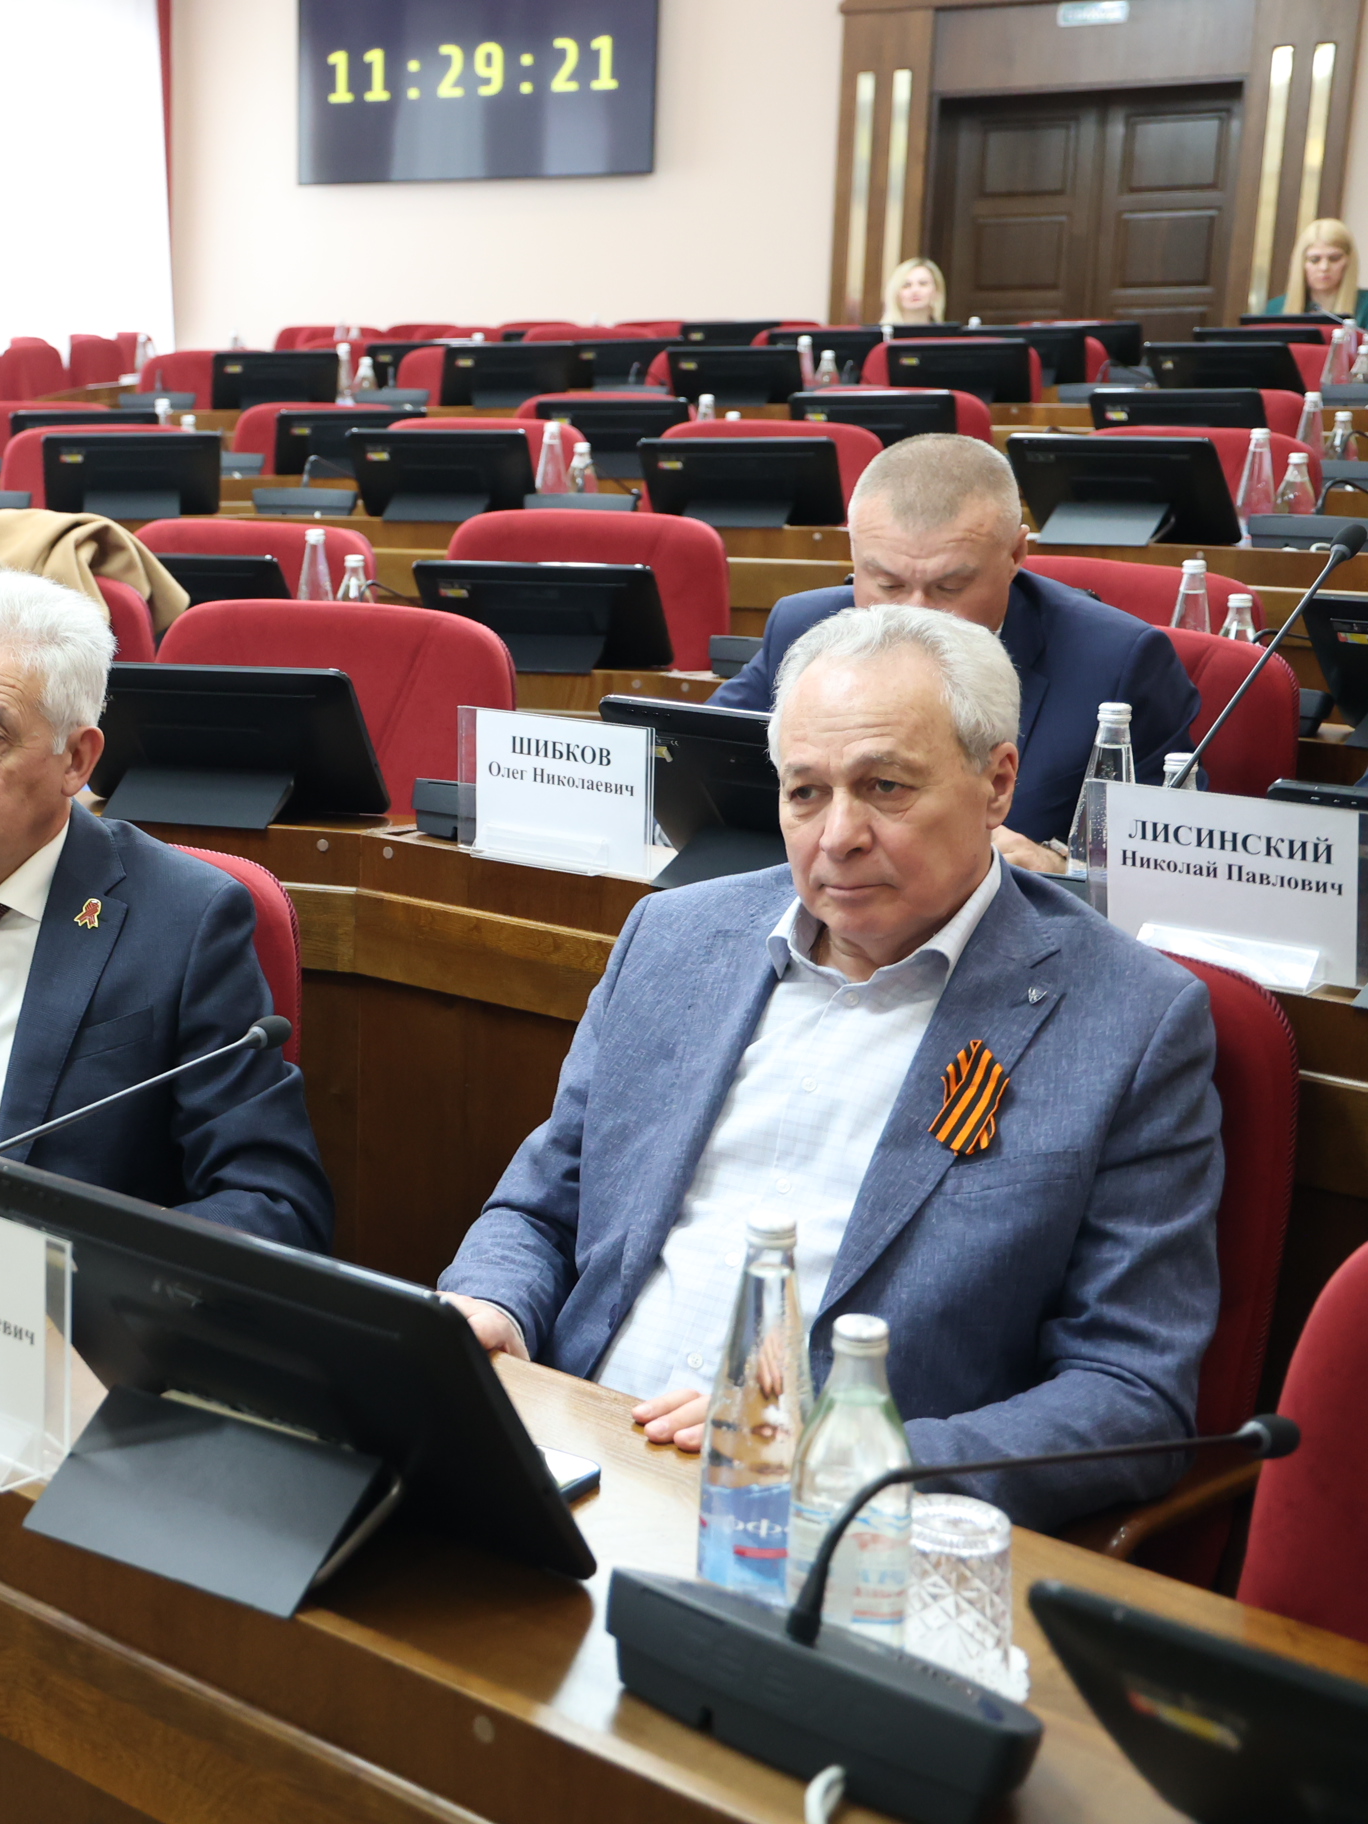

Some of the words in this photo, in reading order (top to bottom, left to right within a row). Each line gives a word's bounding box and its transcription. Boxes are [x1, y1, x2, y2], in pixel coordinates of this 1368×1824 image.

[327, 35, 619, 104] 11:29:21
[511, 735, 612, 767] ШИБКОВ
[488, 760, 528, 781] Олег
[532, 766, 635, 797] Николаевич
[1128, 818, 1334, 866] ЛИСИНСКИЙ
[1120, 848, 1219, 879] Николай
[1226, 862, 1344, 897] Павлович
